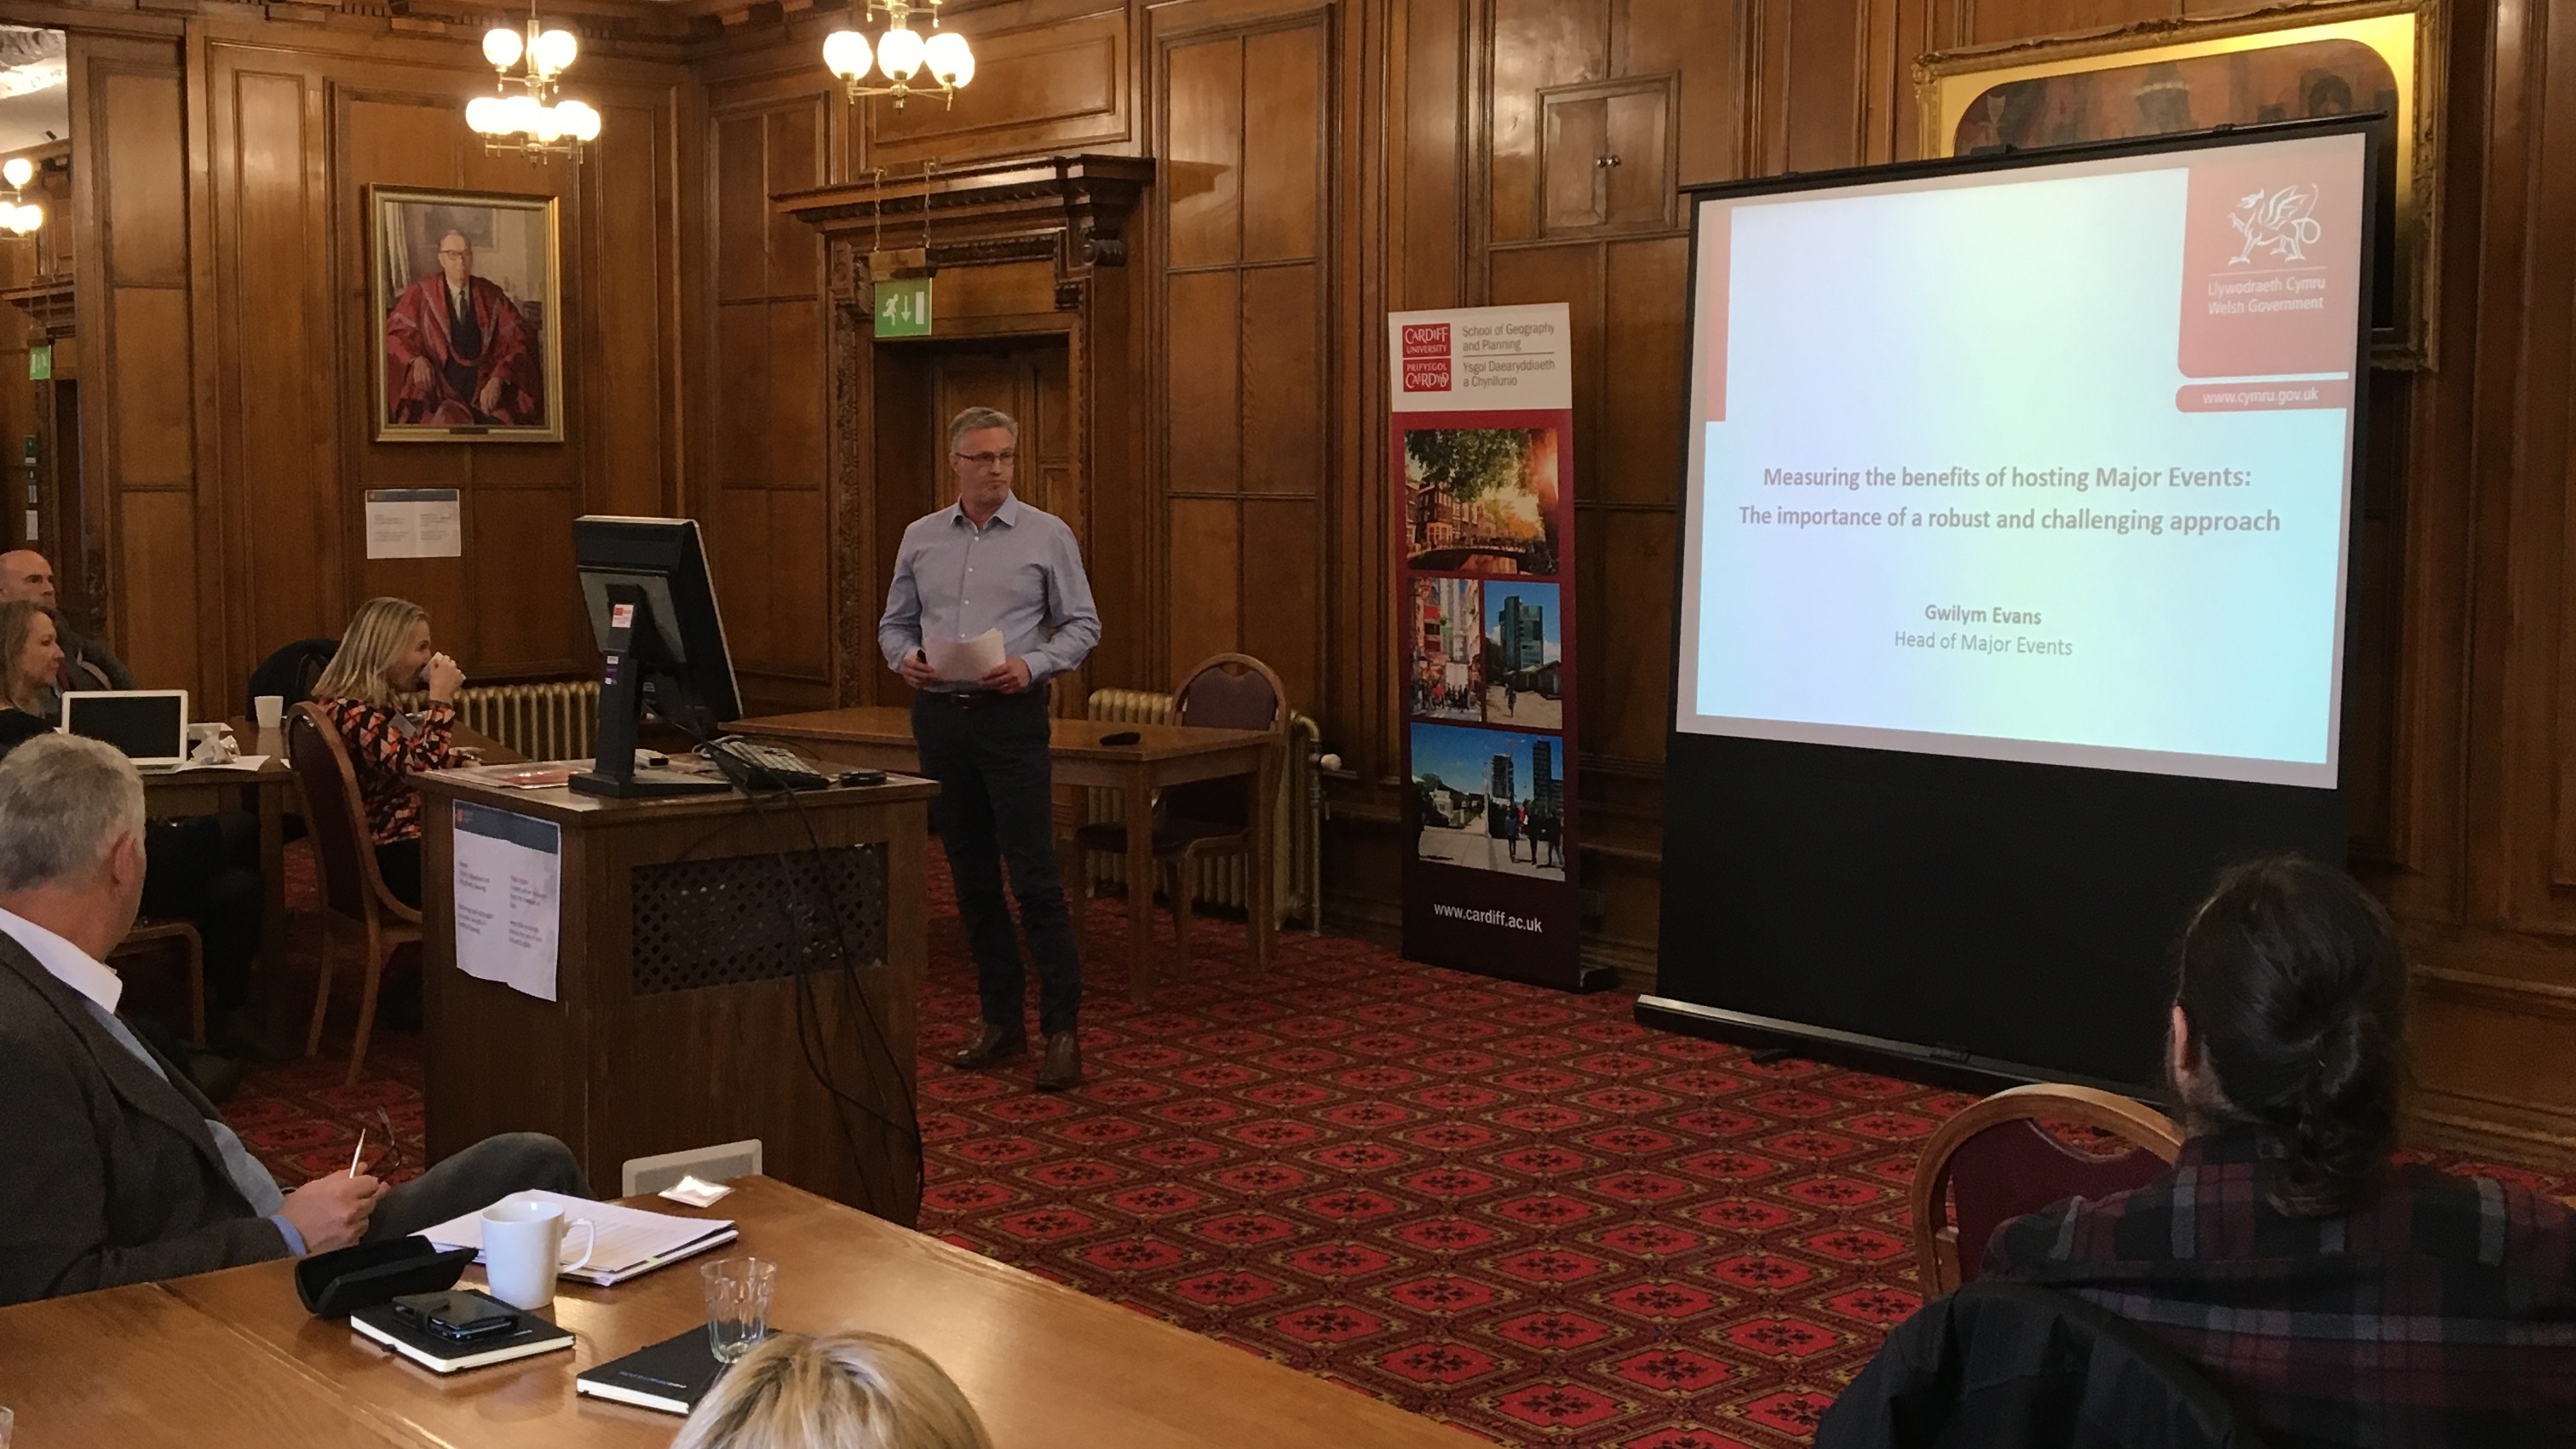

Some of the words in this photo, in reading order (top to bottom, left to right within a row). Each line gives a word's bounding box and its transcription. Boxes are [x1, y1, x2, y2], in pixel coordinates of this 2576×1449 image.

[2208, 278, 2283, 299] Llywodraeth
[2286, 276, 2326, 292] Cymru
[2207, 302, 2245, 315] Welsh
[2248, 296, 2324, 313] Government
[1405, 326, 1448, 344] CARDIFF
[1462, 325, 1492, 337] School
[1495, 324, 1504, 335] of
[1506, 322, 1555, 337] Geography
[1406, 344, 1446, 354] UNIVERSITY
[1463, 342, 1481, 352] and
[1482, 339, 1521, 352] Planning
[1406, 361, 1447, 372] PRIFYSGOL
[1463, 361, 1486, 375] Ysgol
[1491, 359, 1555, 372] Daearyddiaeth
[1471, 375, 1518, 389] Chynllunio
[2203, 387, 2319, 405] www.cymru.gov.uk
[1763, 467, 1860, 491] Measuring
[1865, 466, 1896, 486] the
[1902, 466, 1981, 487] benefits
[1985, 466, 2007, 487] of
[2011, 466, 2090, 492] hosting
[2096, 466, 2162, 492] Major
[2169, 467, 2251, 487] Events:
[1739, 505, 1773, 525] The
[1777, 506, 1883, 529] importance
[1887, 507, 1908, 526] of
[1912, 513, 1923, 527] a
[1929, 507, 1991, 528] robust
[1996, 508, 2035, 529] and
[2041, 508, 2164, 536] challenging
[2170, 509, 2281, 537] approach
[1924, 603, 1987, 625] Gwilym
[1992, 607, 2042, 625] Evans
[1895, 630, 1935, 648] Head
[1940, 632, 1957, 649] of
[1961, 634, 2011, 655] Major
[2016, 636, 2073, 656] Events
[1434, 903, 1543, 933] www.cardiff.ac.uk
